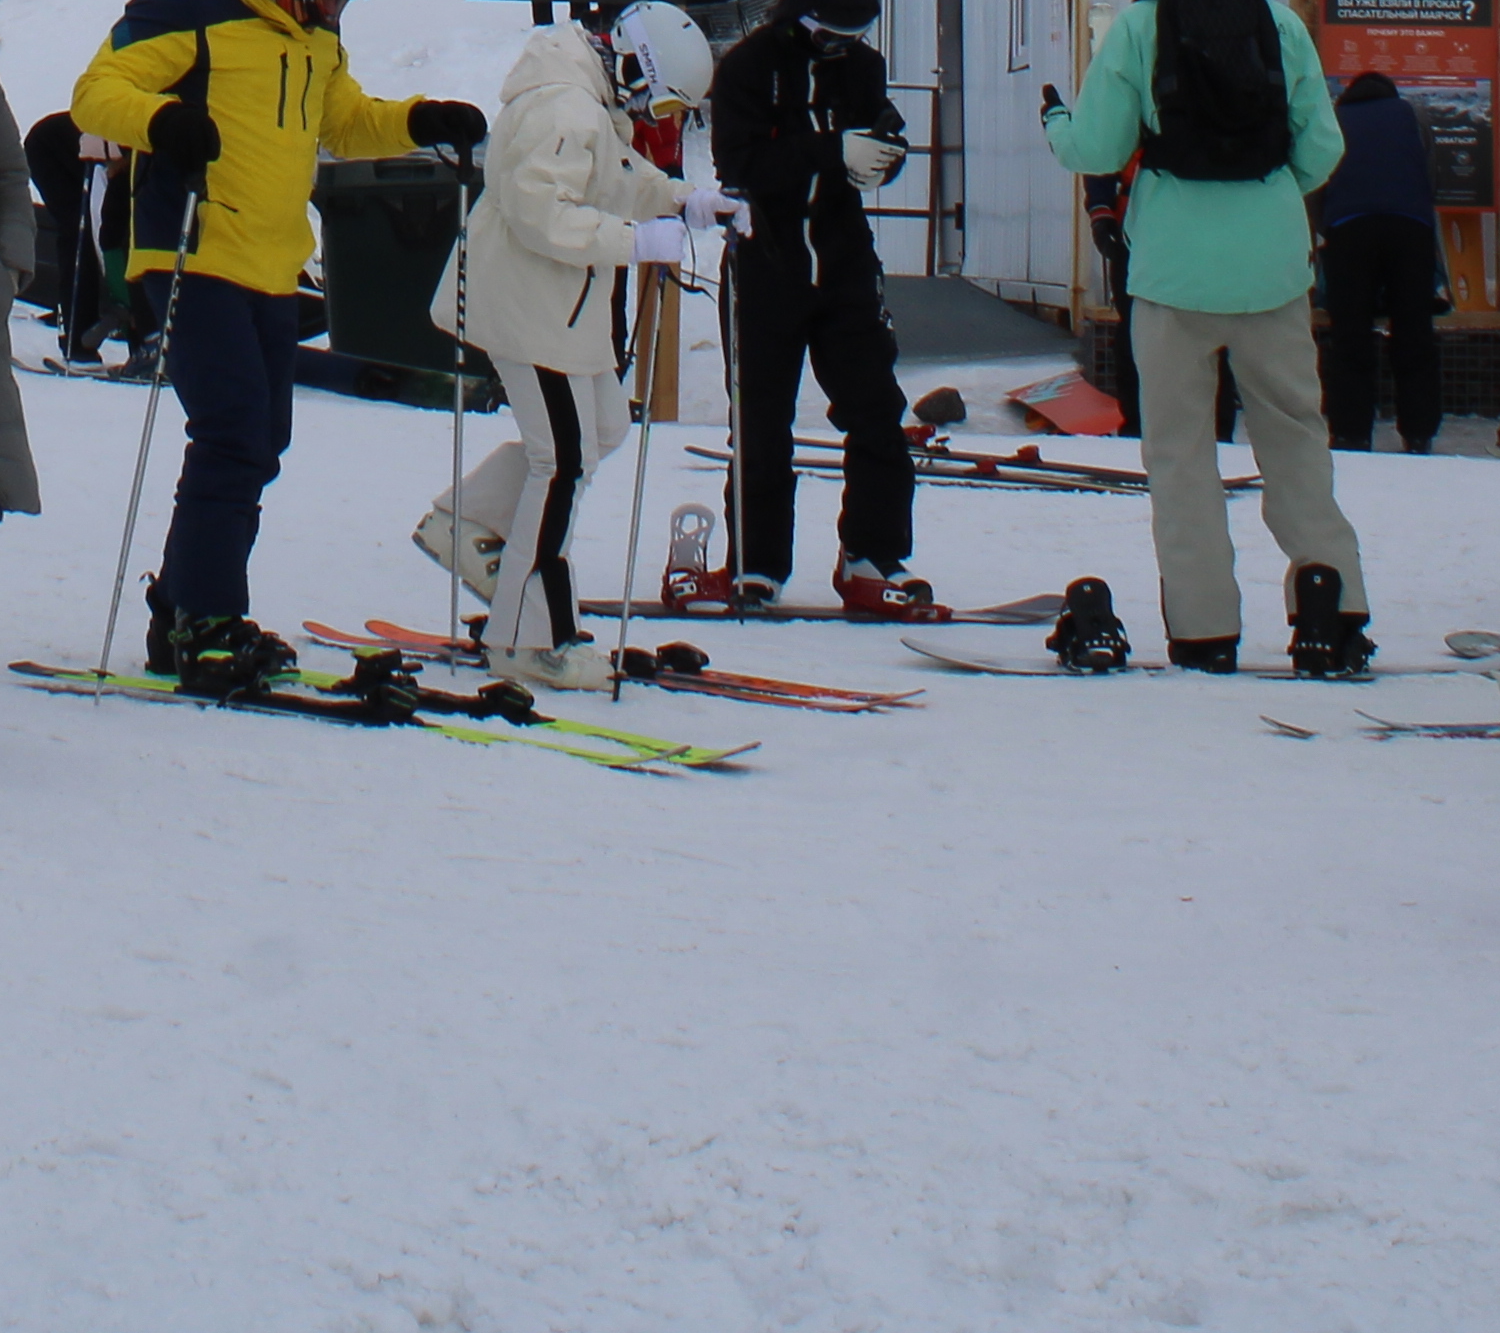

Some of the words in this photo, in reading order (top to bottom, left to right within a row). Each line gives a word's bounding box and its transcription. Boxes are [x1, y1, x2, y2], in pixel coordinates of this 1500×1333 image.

[1422, 0, 1461, 10] ПРОКАТ
[1337, 8, 1418, 20] СПАСАТЕЛЬНЫЙ
[1419, 10, 1463, 21] МАЯЧОК
[1366, 28, 1399, 37] ПОЧЕМУ
[1400, 29, 1415, 37] ЭТО
[638, 42, 659, 84] SMITH
